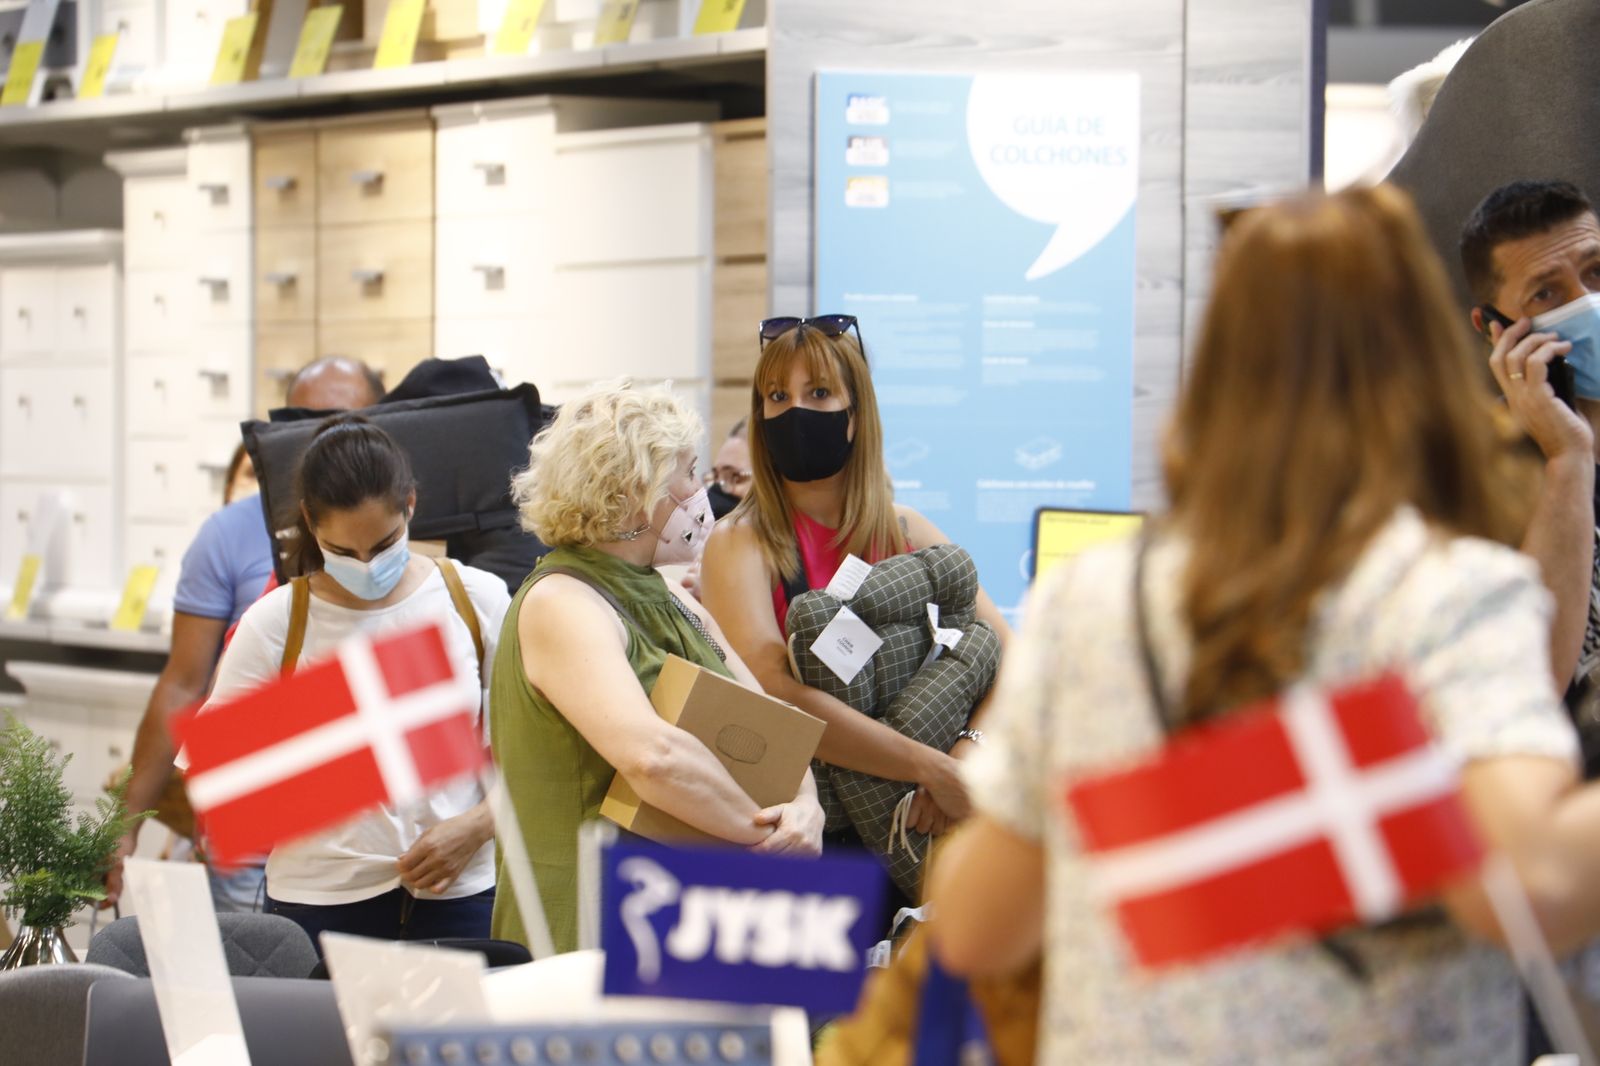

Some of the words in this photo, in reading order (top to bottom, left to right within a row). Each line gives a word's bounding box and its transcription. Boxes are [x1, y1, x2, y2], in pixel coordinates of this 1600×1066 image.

[1076, 113, 1105, 136] DE
[990, 144, 1128, 167] COLCHONES
[667, 886, 859, 973] JYSK
